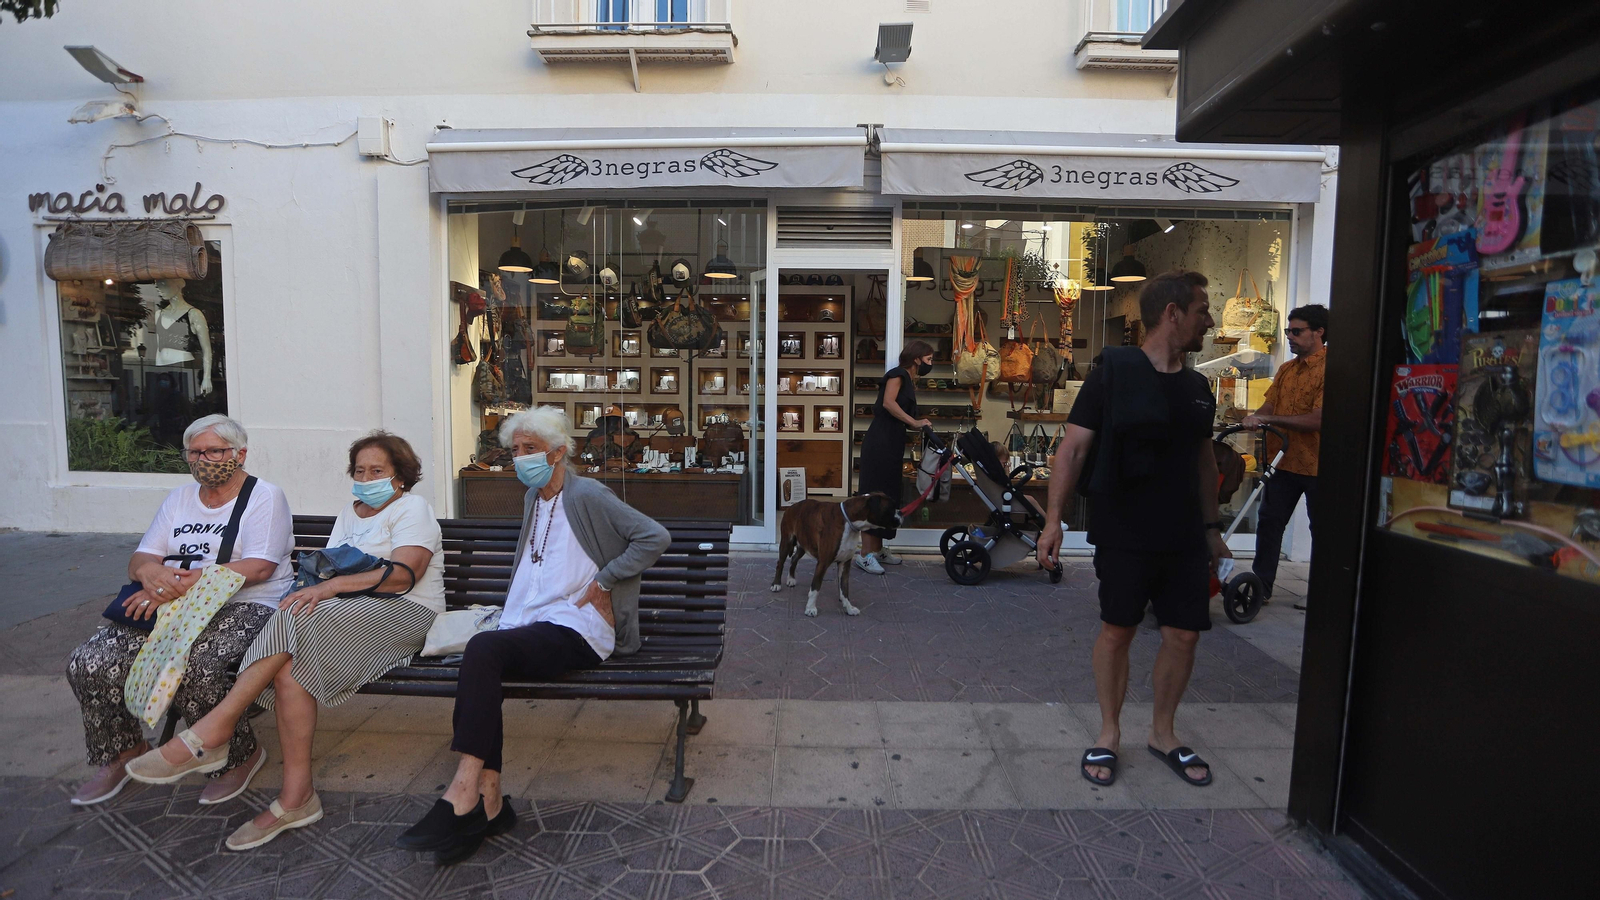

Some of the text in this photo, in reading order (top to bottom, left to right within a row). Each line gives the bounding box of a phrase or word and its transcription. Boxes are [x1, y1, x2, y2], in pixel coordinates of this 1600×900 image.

[590, 159, 696, 179] 3negras
[1050, 165, 1158, 189] 3negras
[143, 182, 225, 214] malo
[1396, 376, 1443, 391] WARRIOR
[173, 523, 215, 538] BORN
